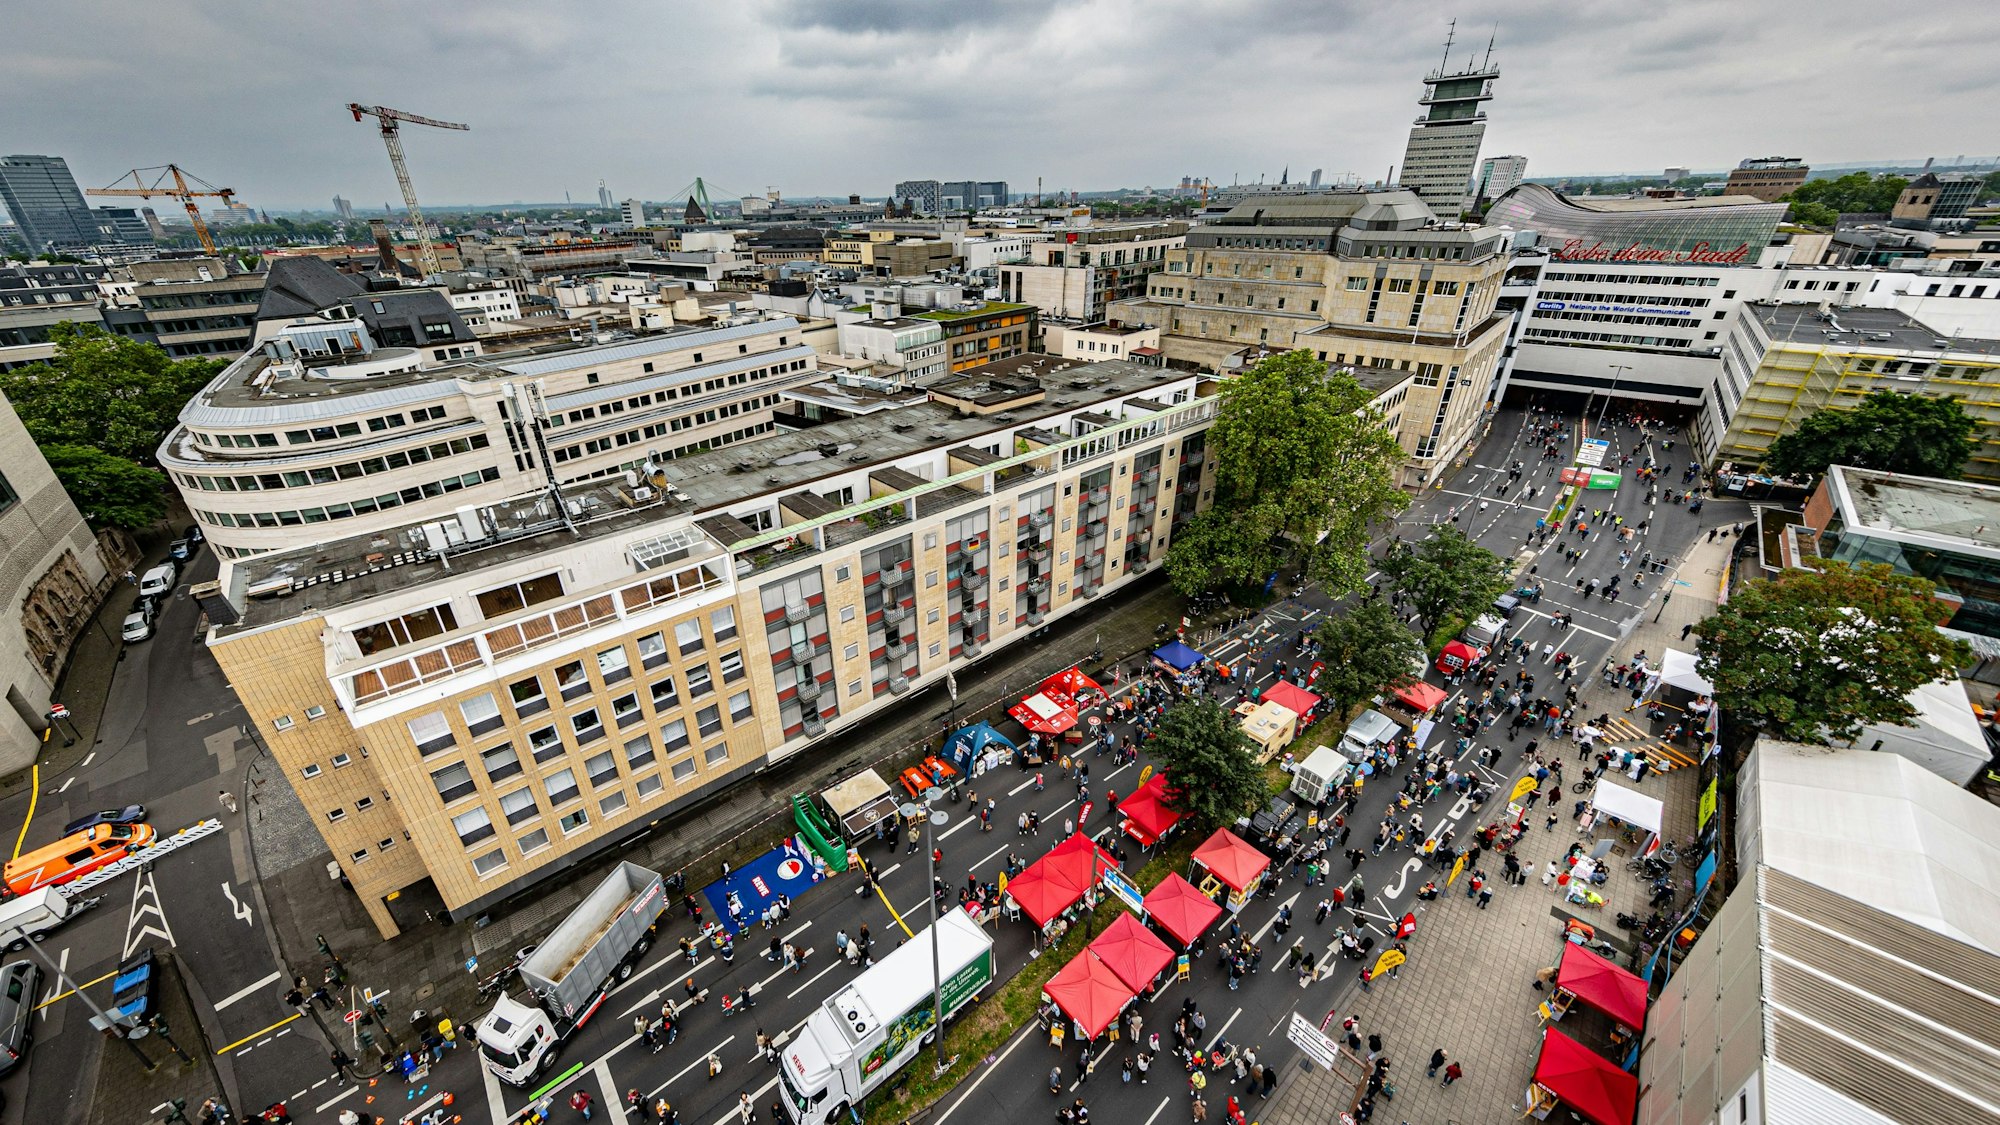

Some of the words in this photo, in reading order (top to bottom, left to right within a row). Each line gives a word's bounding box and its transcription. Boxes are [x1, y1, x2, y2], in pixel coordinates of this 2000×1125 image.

[1557, 239, 1609, 262] Liebe
[1613, 241, 1671, 262] deine
[1676, 242, 1749, 263] Stadt
[1569, 303, 1597, 312] Helping
[1636, 307, 1692, 316] Communicate
[752, 875, 770, 898] REWE
[949, 975, 987, 1009] #UMDENKBAR
[1559, 985, 1577, 998] REWE
[792, 1054, 806, 1076] REWE
[1537, 1082, 1557, 1097] REWE
